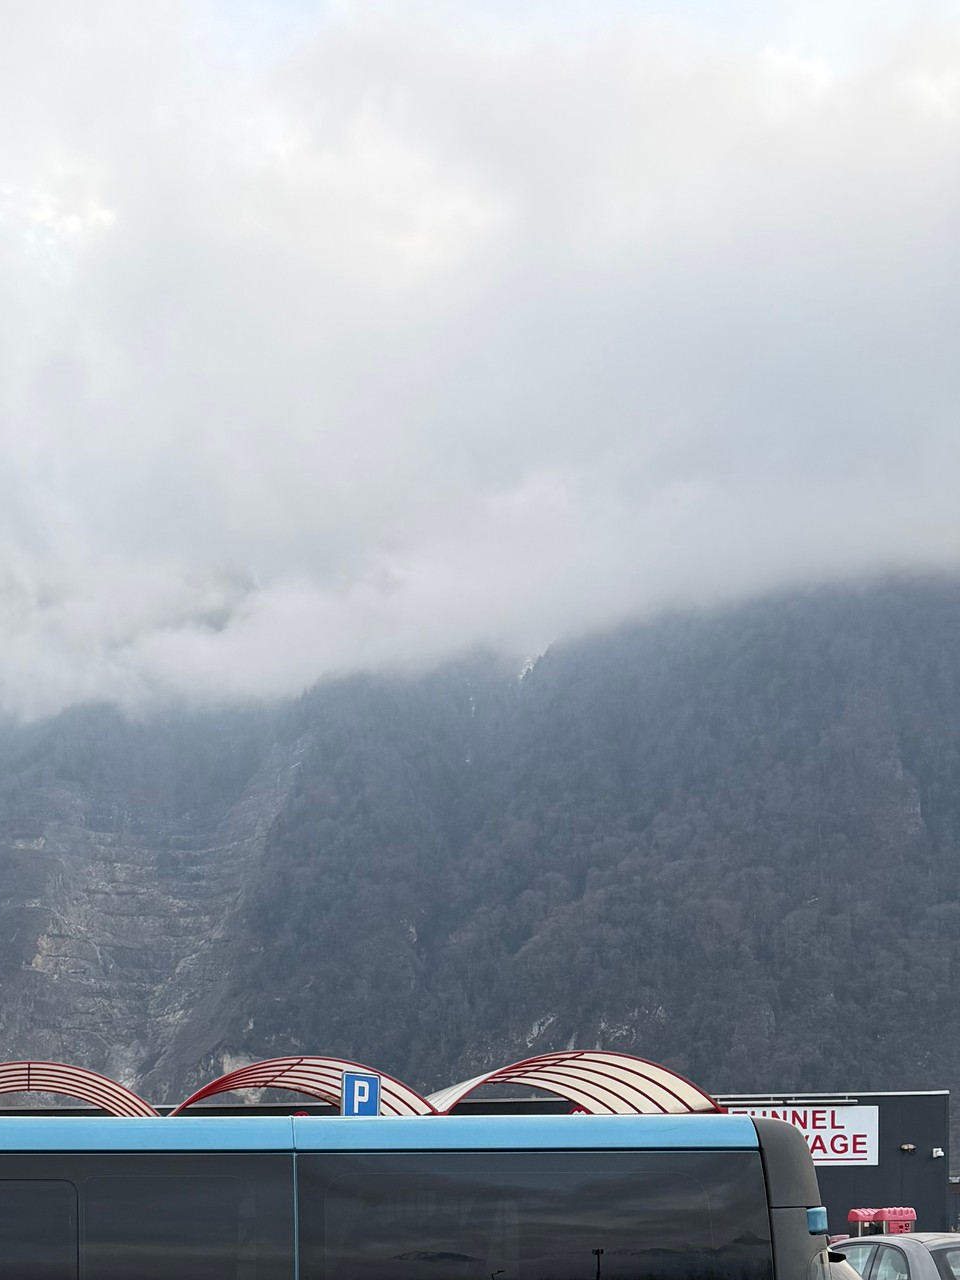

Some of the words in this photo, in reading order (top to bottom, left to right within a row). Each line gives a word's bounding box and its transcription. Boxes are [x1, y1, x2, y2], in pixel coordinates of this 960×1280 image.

[353, 1080, 370, 1114] P
[732, 1109, 845, 1130] NEL
[804, 1134, 868, 1154] AGE
